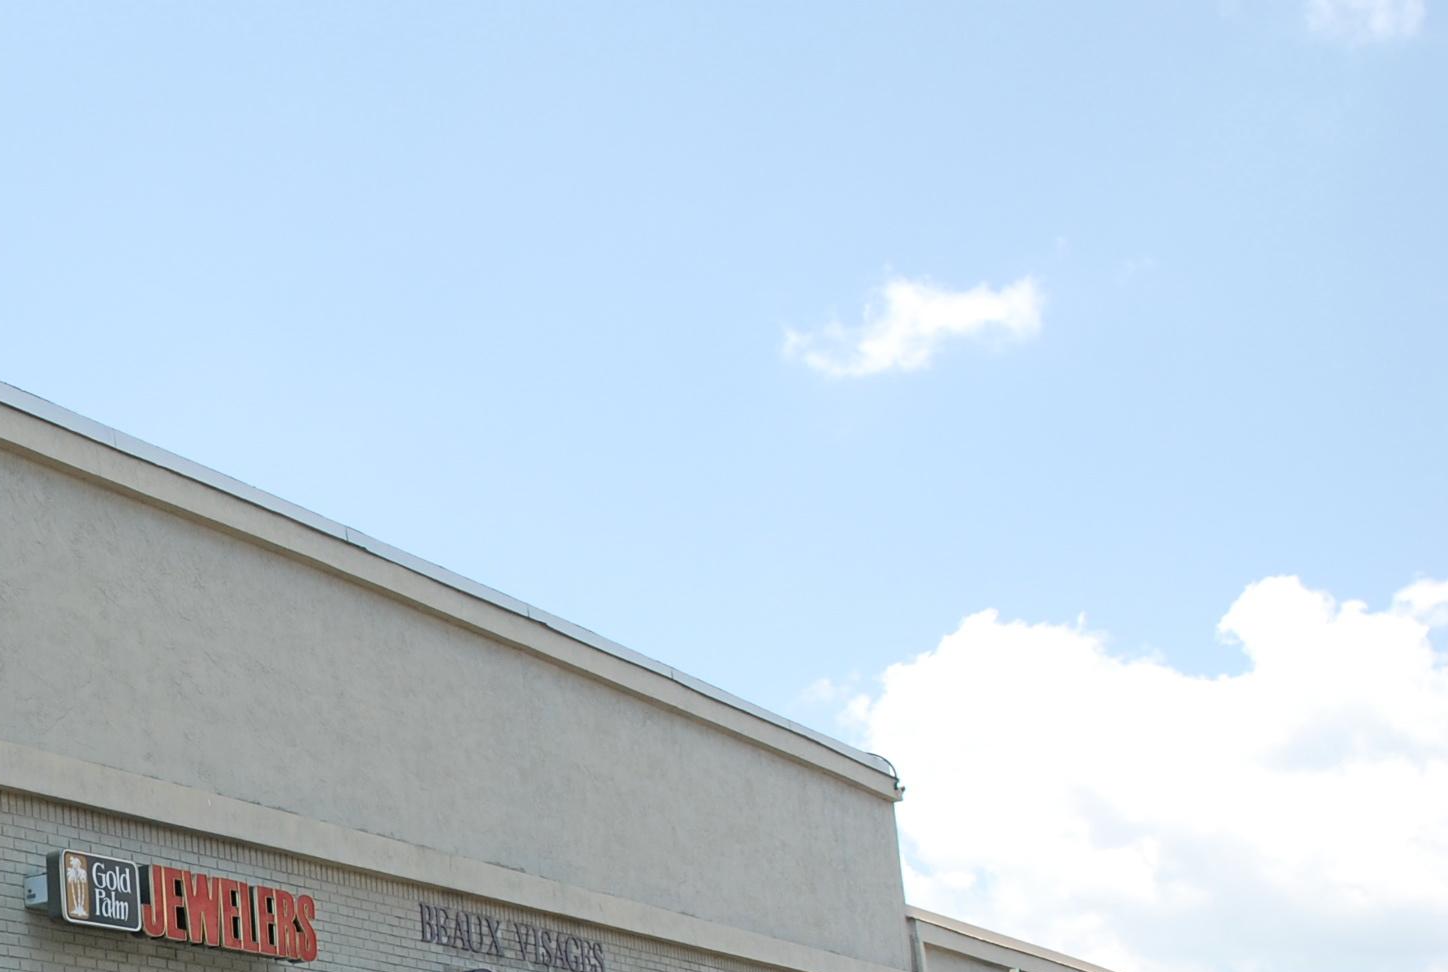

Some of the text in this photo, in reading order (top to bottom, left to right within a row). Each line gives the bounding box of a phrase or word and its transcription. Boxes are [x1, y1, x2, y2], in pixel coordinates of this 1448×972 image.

[92, 862, 131, 894] Gold
[95, 888, 129, 921] Palm
[142, 864, 319, 963] JEWELERS
[419, 903, 503, 957] BEAUX
